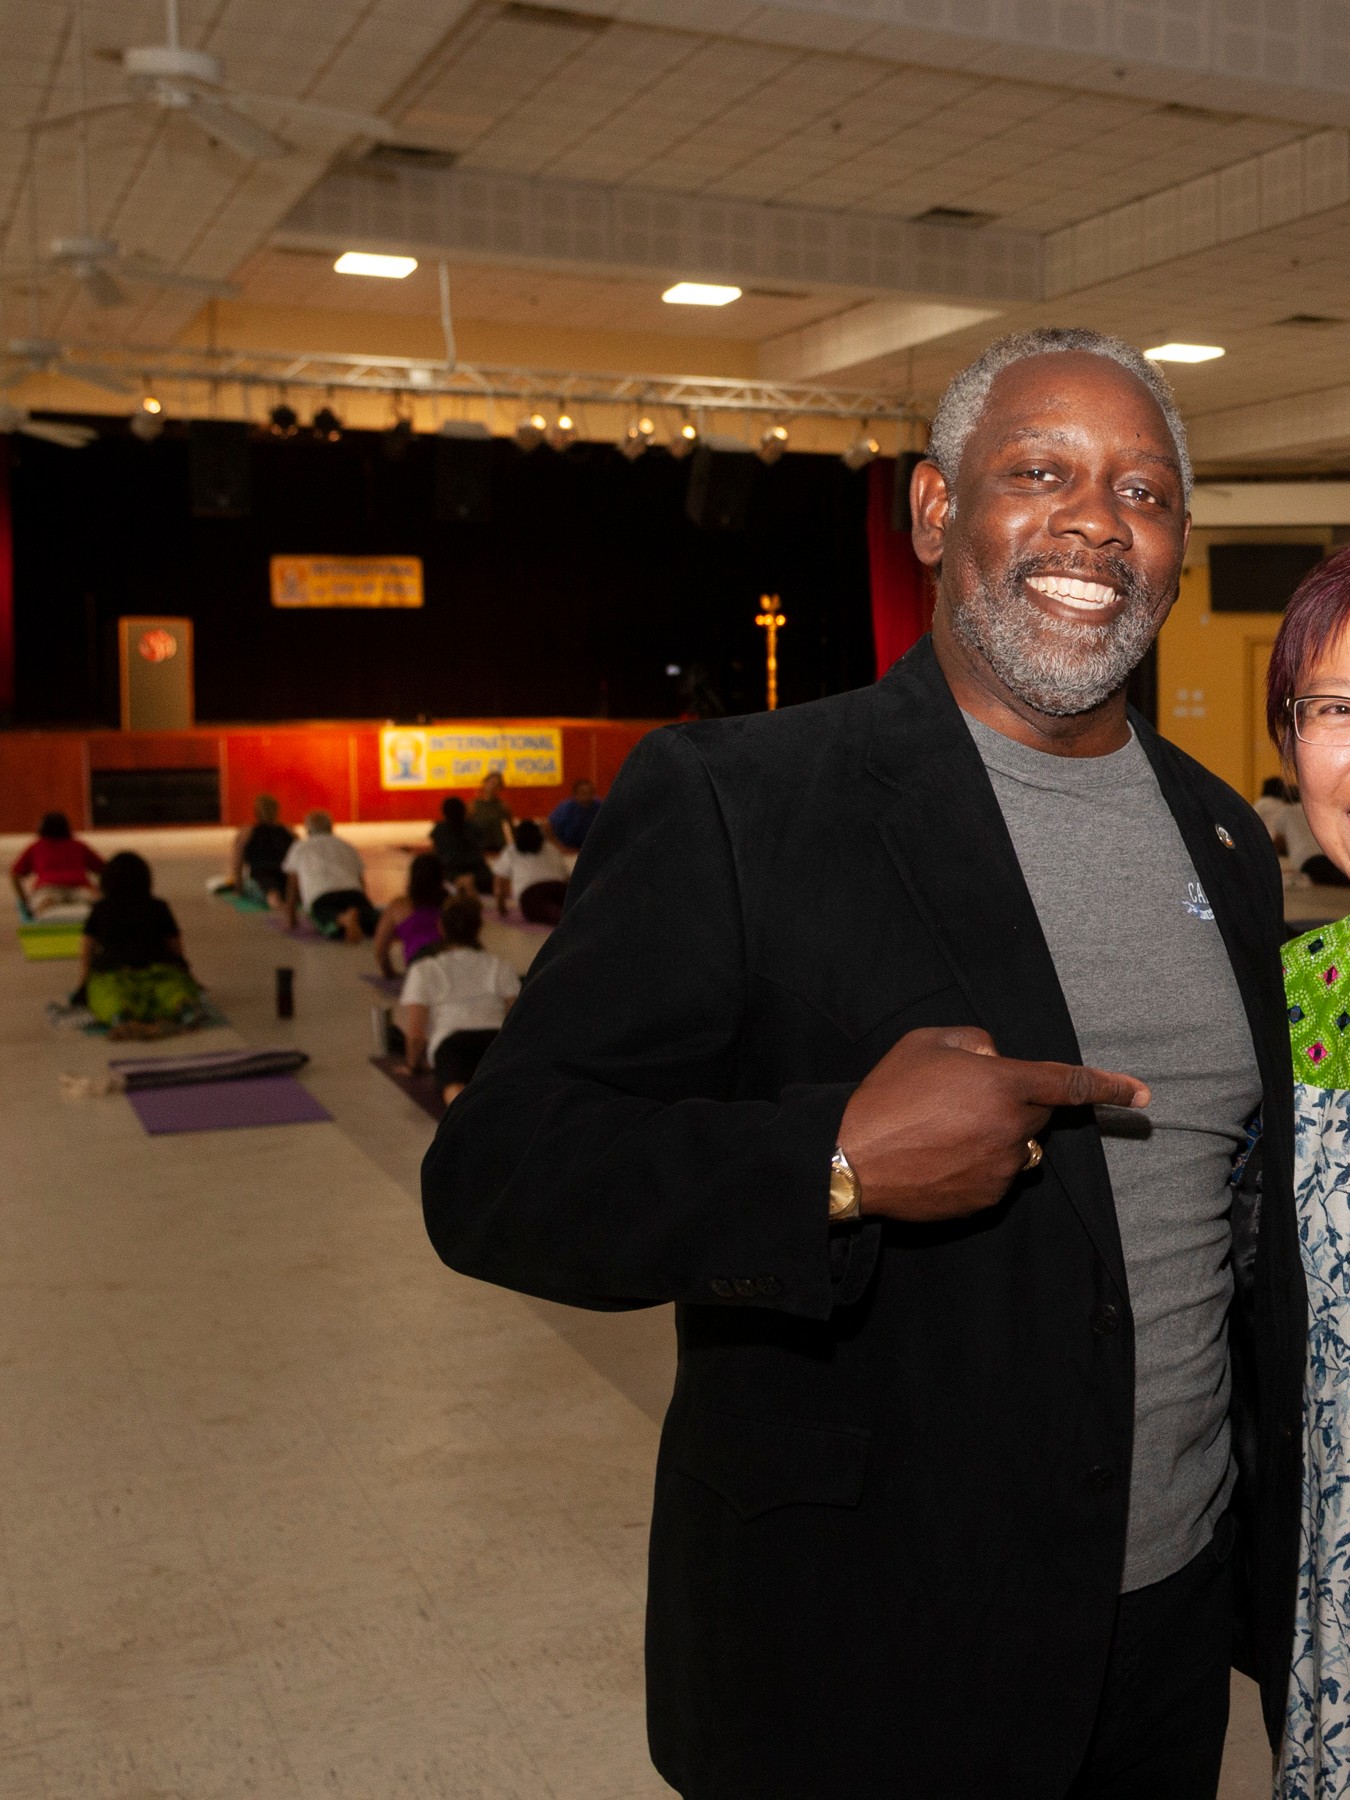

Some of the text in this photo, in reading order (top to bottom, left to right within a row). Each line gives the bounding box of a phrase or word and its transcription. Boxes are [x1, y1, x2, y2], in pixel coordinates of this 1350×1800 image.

[430, 734, 556, 751] INTERNATIONAL
[452, 758, 483, 774] DAY
[514, 757, 557, 774] YOGA
[1187, 881, 1210, 904] CA
